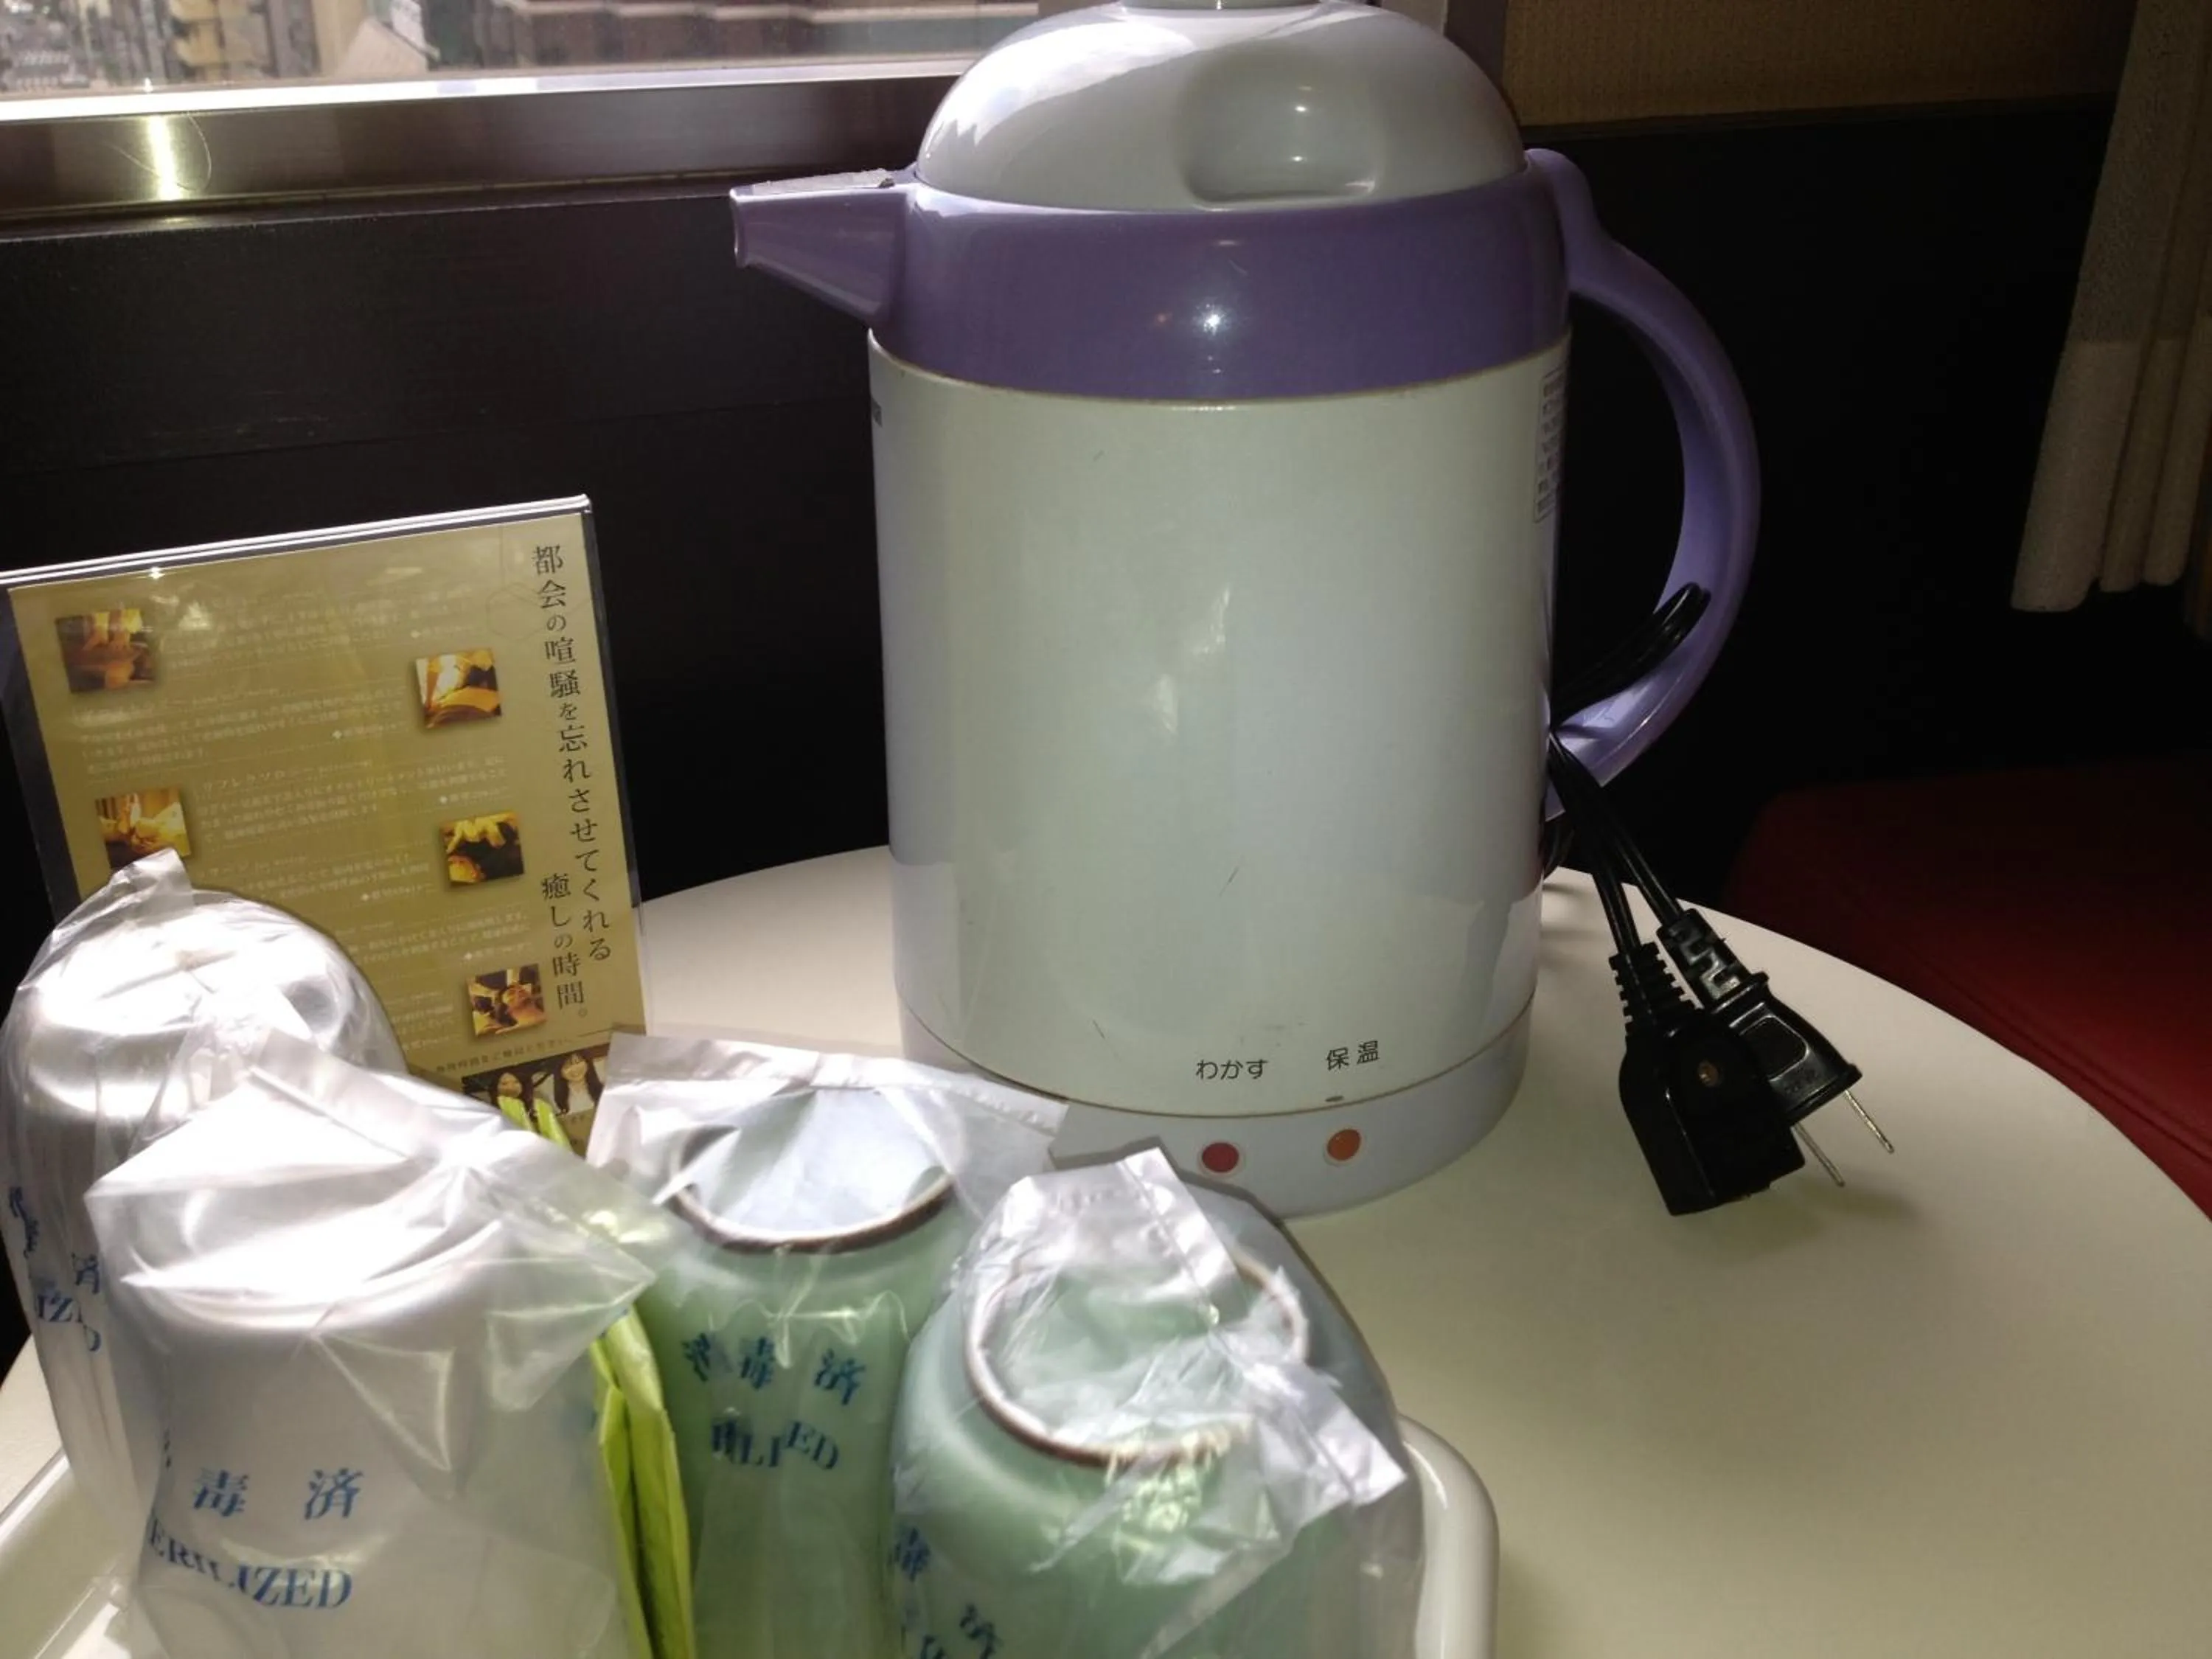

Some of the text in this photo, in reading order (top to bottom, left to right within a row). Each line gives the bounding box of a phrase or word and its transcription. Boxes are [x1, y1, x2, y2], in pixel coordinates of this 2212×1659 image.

[532, 545, 612, 961] 都会の喧騒を忘れさせてくれる
[1195, 1058, 1268, 1079] わかす
[1325, 1040, 1380, 1071] 保温
